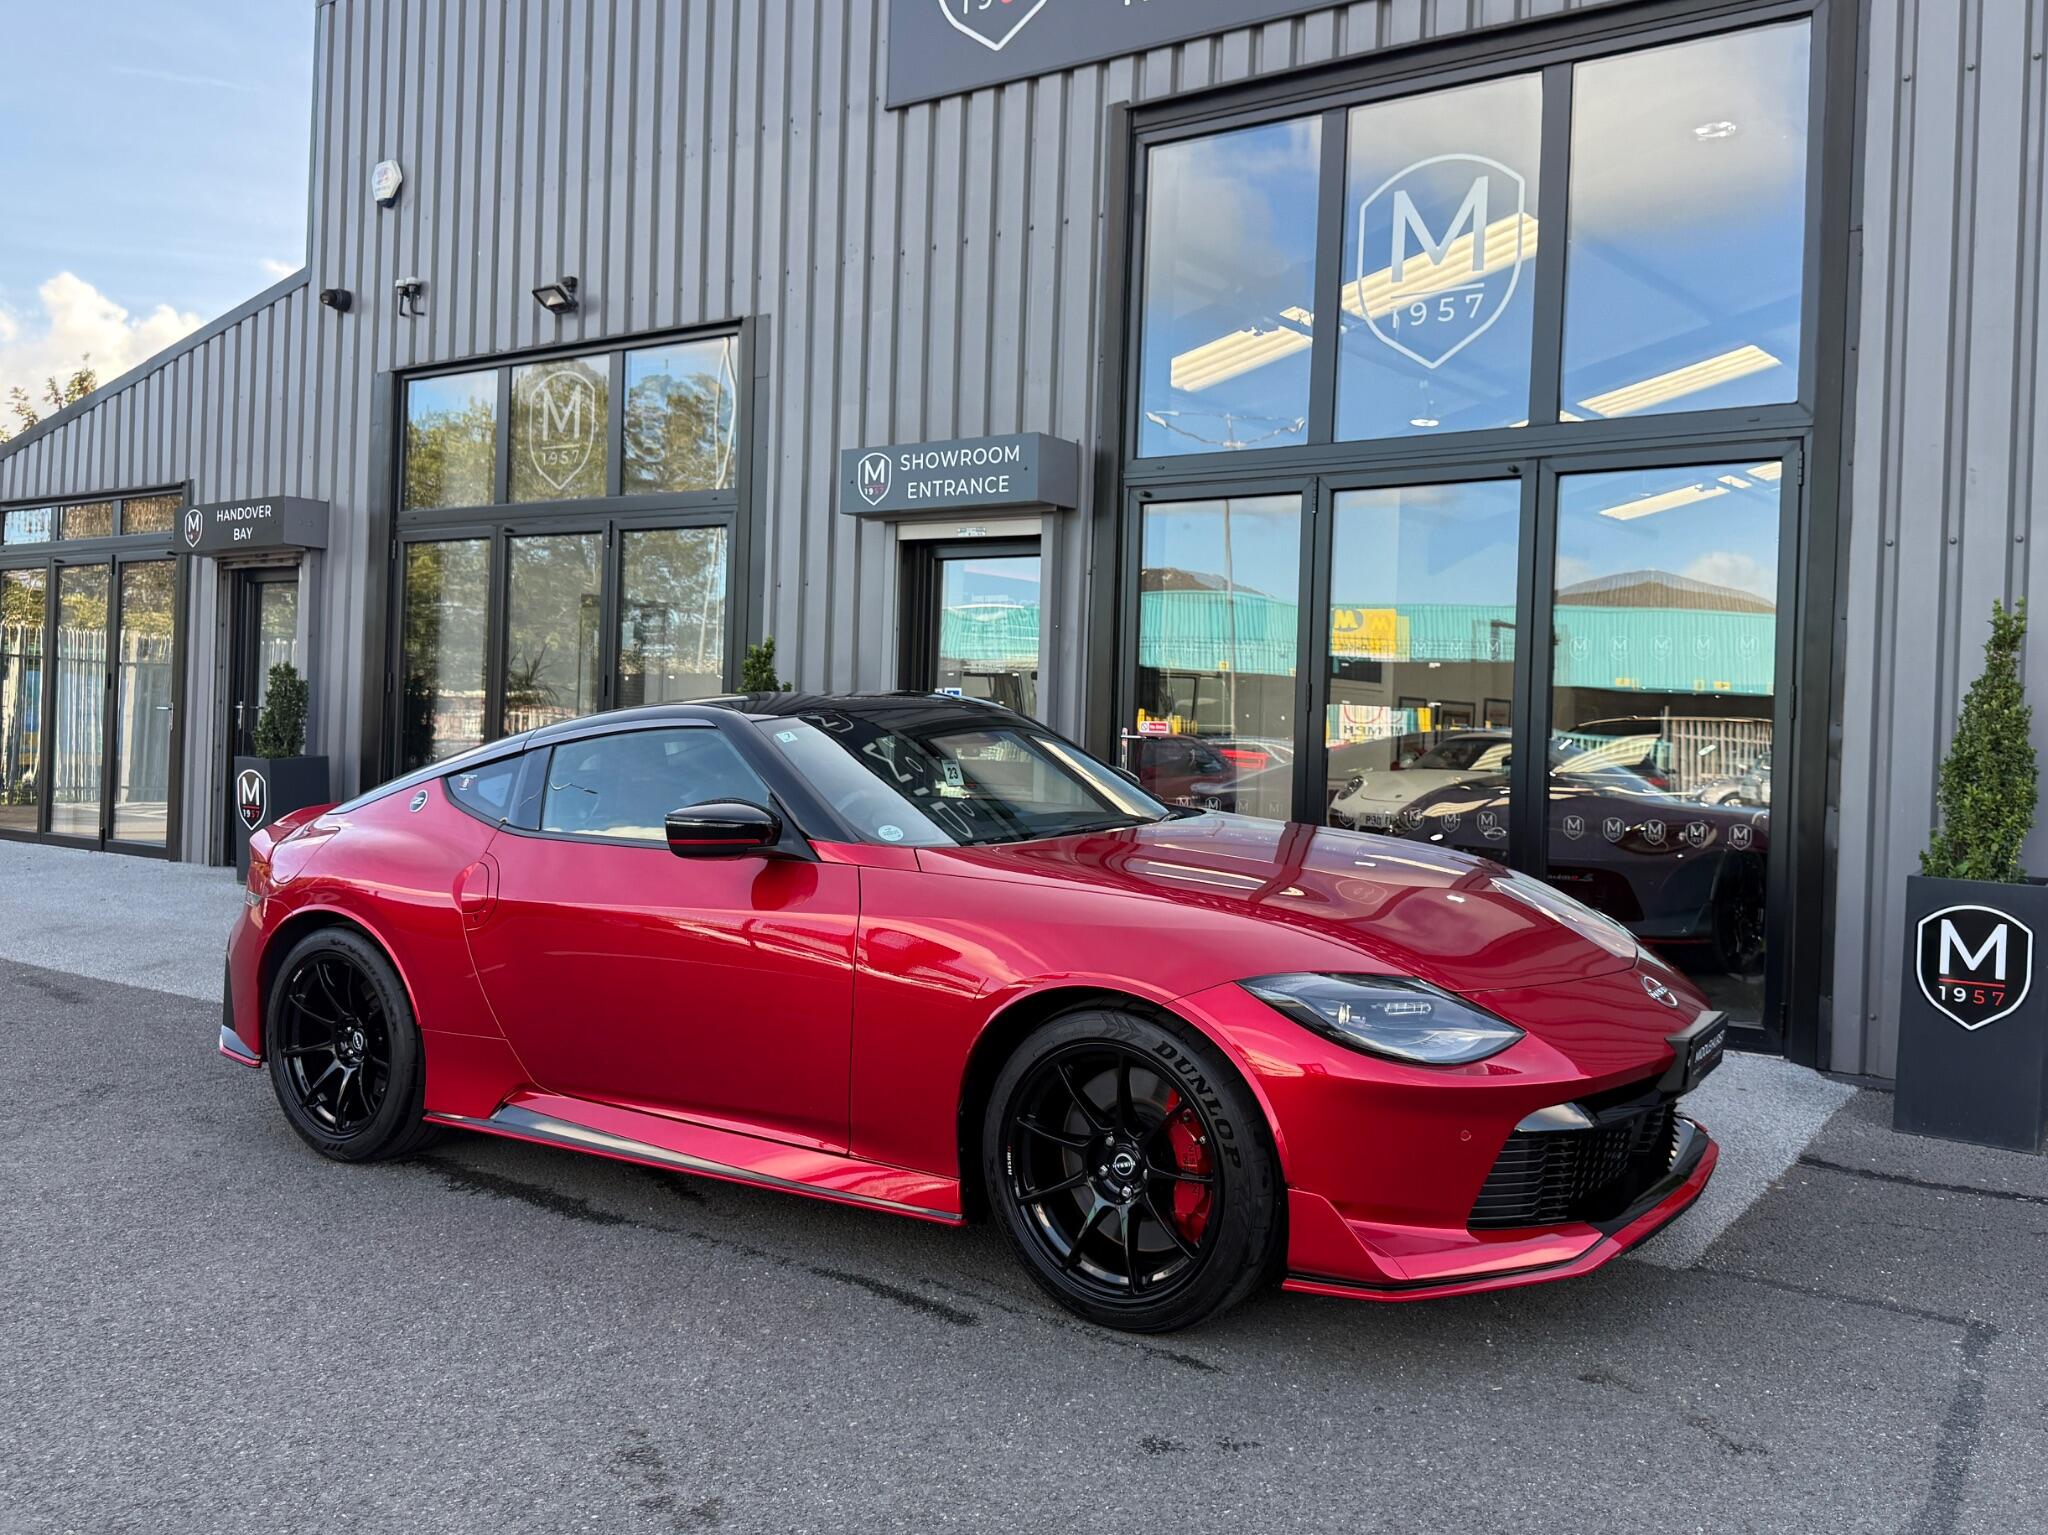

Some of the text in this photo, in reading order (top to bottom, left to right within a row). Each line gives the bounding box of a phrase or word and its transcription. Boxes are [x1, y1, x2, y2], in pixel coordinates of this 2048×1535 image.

[1391, 175, 1488, 283] M
[1391, 293, 1483, 328] 1957
[543, 384, 581, 440] M
[541, 450, 579, 466] 1957
[900, 445, 1020, 471] SHOWROOM
[865, 459, 884, 484] M
[907, 475, 1010, 499] ENTRANCE
[188, 514, 199, 532] M
[216, 504, 272, 522] HANDOVER
[233, 527, 253, 541] BAY
[243, 777, 260, 805] M
[1208, 800, 1218, 810] M
[1481, 814, 1493, 826] M
[1567, 818, 1580, 831] M
[1607, 820, 1620, 833] M
[1647, 823, 1662, 835] M
[1733, 827, 1748, 840] M
[1939, 918, 2007, 981] M
[1938, 985, 2005, 1007] 1957
[1152, 1040, 1242, 1169] DUNLOP
